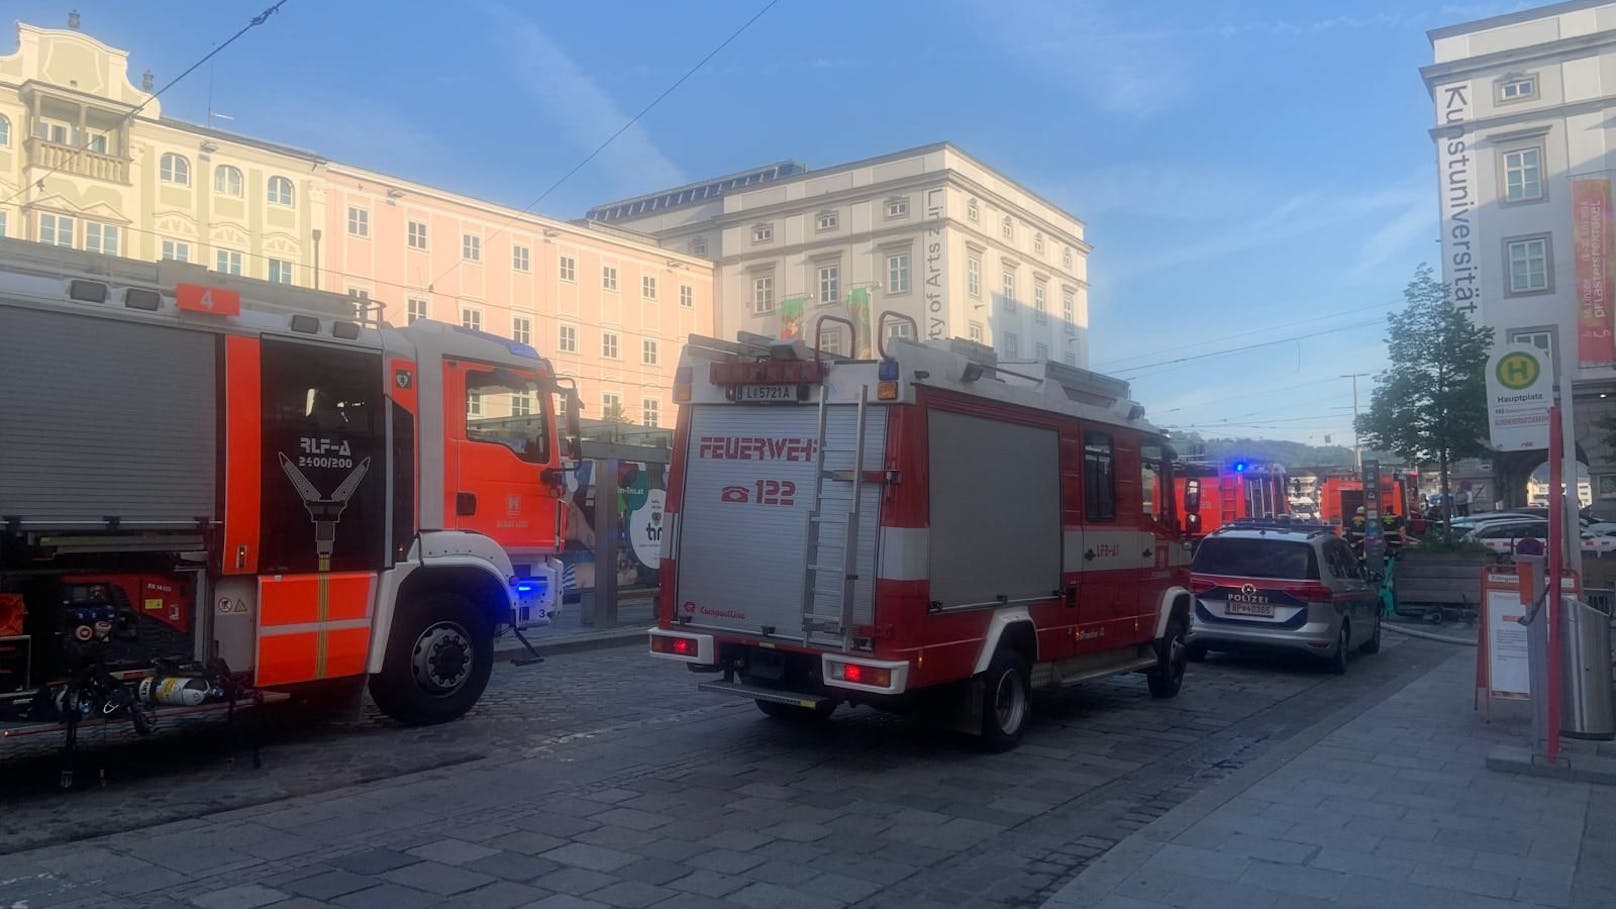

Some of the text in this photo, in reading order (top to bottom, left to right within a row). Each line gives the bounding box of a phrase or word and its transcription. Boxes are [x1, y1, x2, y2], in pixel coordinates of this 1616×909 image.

[1445, 85, 1479, 315] Kunstuniversität
[925, 242, 942, 288] Arts
[200, 290, 214, 310] 4
[926, 293, 942, 313] of
[1497, 392, 1545, 404] Hauptplatz
[300, 436, 352, 456] RLF-A
[299, 456, 353, 468] 2400/200
[756, 480, 796, 506] 122
[1227, 593, 1269, 604] POLIZEI
[538, 608, 546, 619] 3
